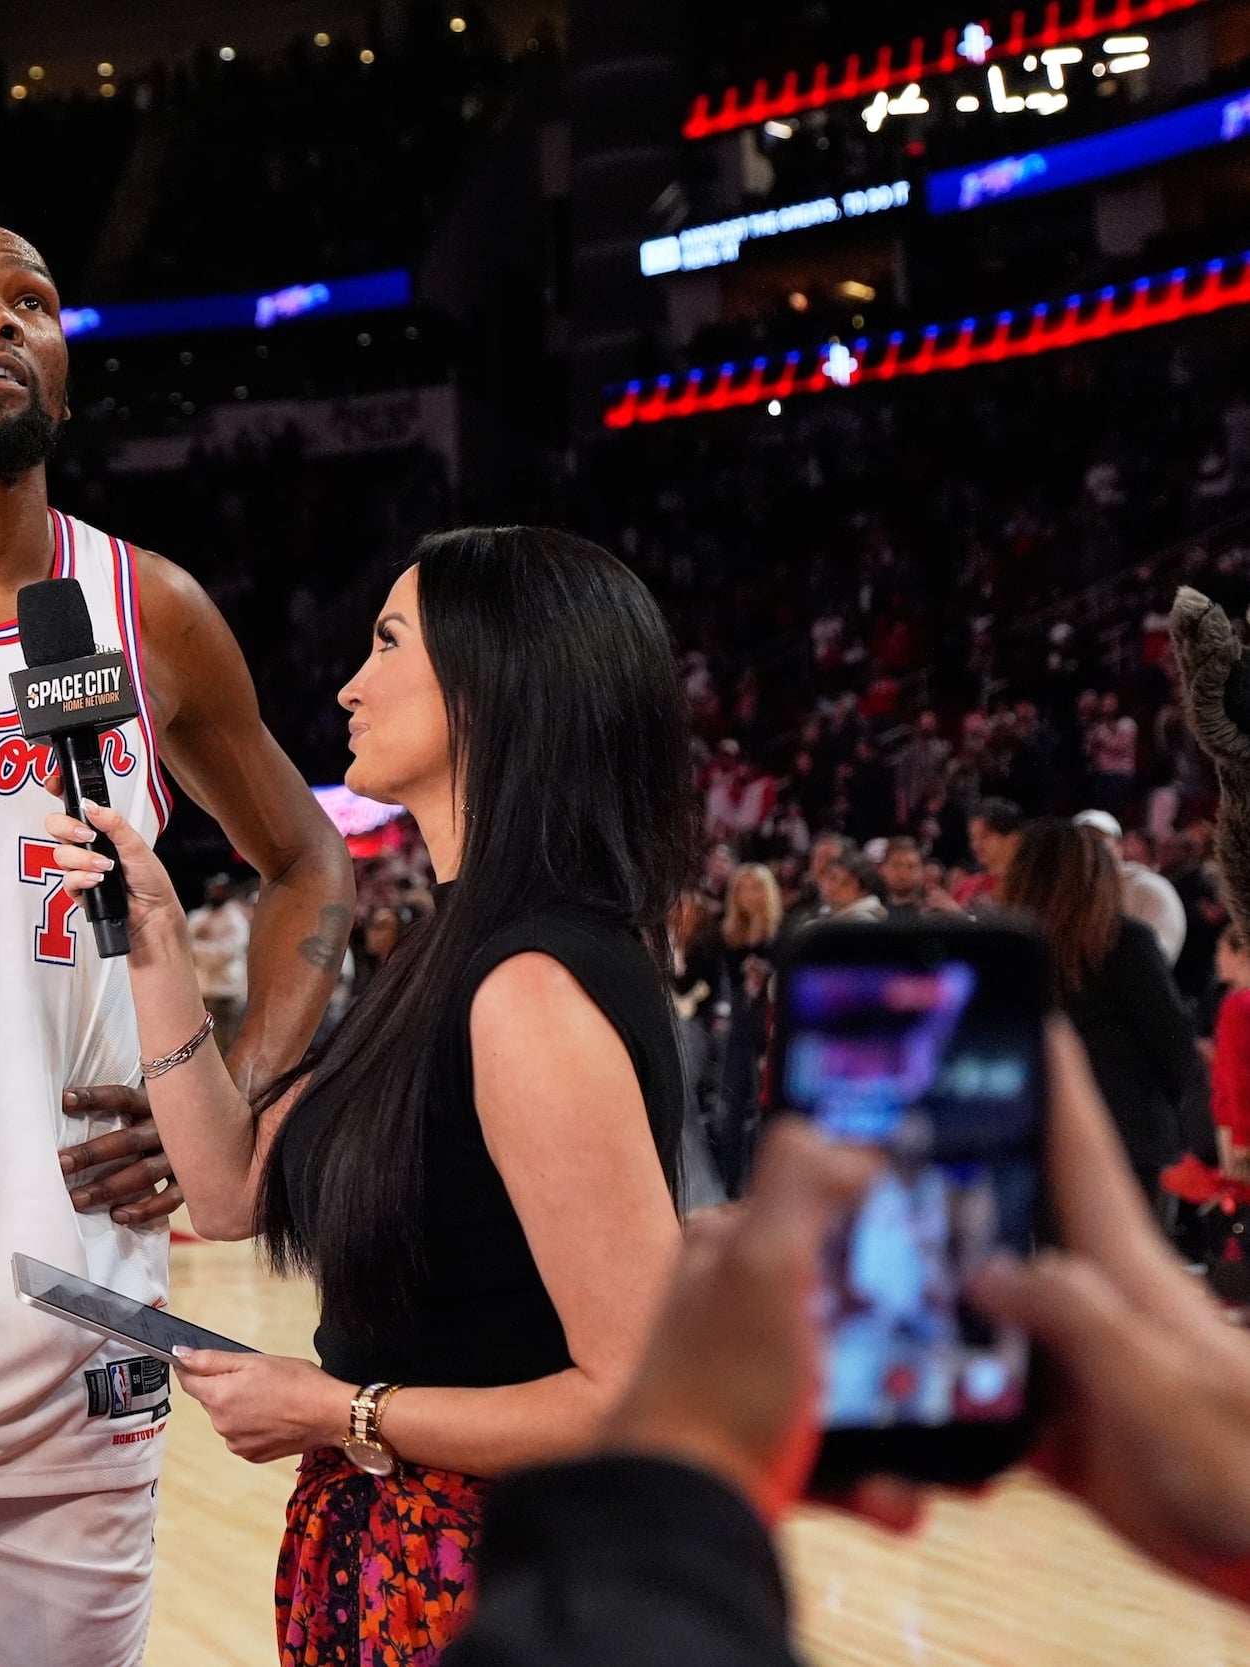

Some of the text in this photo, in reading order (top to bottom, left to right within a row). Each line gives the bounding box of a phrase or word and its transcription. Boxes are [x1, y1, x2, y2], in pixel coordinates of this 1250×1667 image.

[27, 666, 122, 709] SPACE CITY
[62, 691, 120, 713] HOME NETWORK
[18, 836, 82, 967] 7
